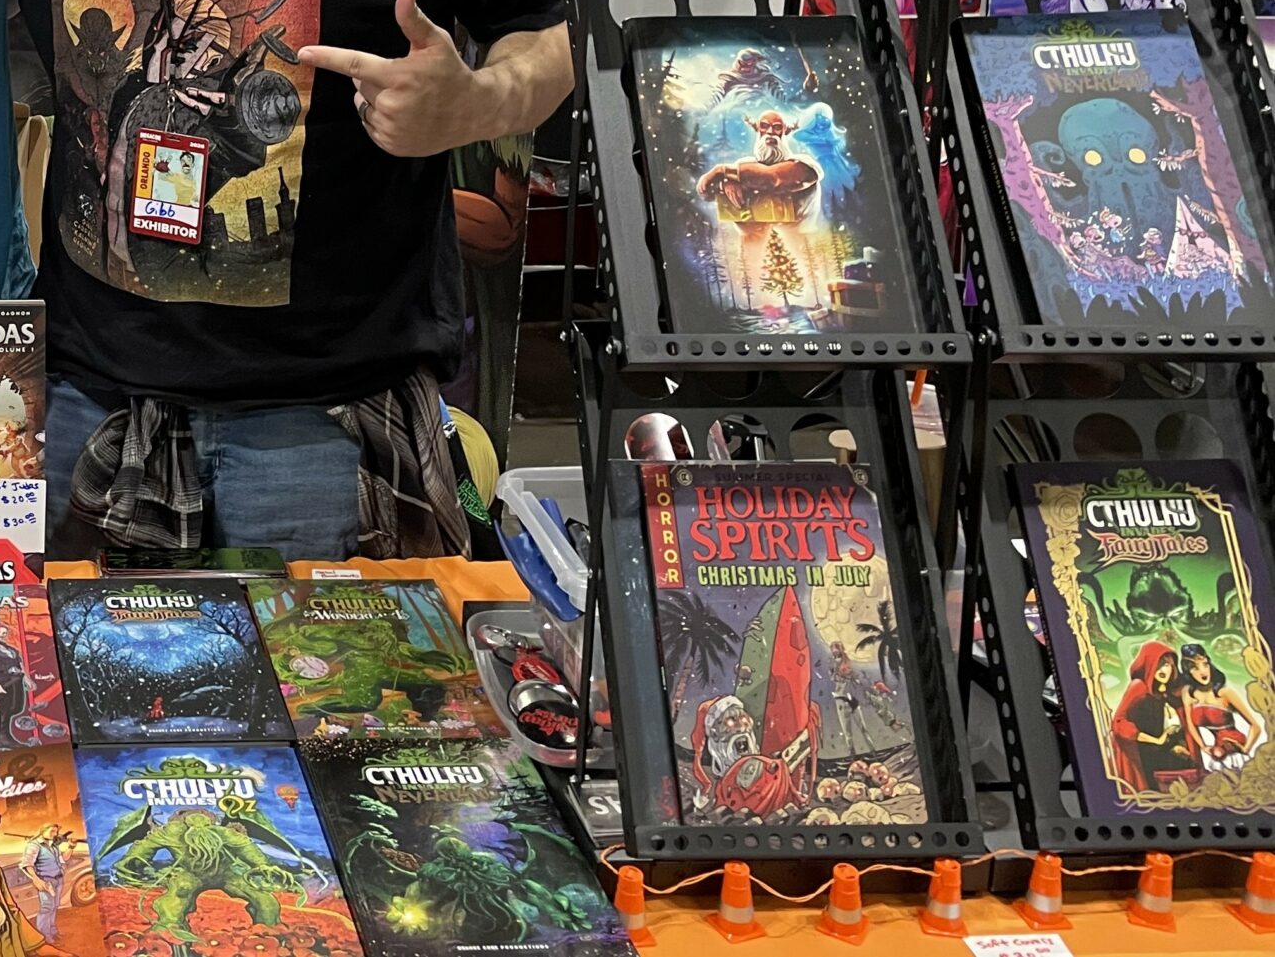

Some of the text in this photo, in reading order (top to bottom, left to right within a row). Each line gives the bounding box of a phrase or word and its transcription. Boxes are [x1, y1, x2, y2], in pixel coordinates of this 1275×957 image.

[1033, 42, 1137, 69] CTHULHU
[140, 151, 151, 190] ORLANDO
[144, 201, 176, 218] Gibb
[133, 218, 197, 239] EXHIBITOR
[12, 481, 39, 491] Judas
[715, 472, 831, 482] SUMMER SPECIAL
[694, 485, 857, 520] HOLIDAY
[1086, 498, 1198, 528] CTHULHU
[655, 472, 680, 583] HORROR
[689, 519, 875, 563] SPIRITS
[697, 564, 871, 587] CHRISTMAS IN JULY
[105, 596, 194, 608] CTHULHU
[309, 598, 398, 610] CTHULHU
[365, 766, 485, 785] CTHULHU
[124, 778, 256, 799] CTHULHU
[148, 796, 217, 807] INVADES
